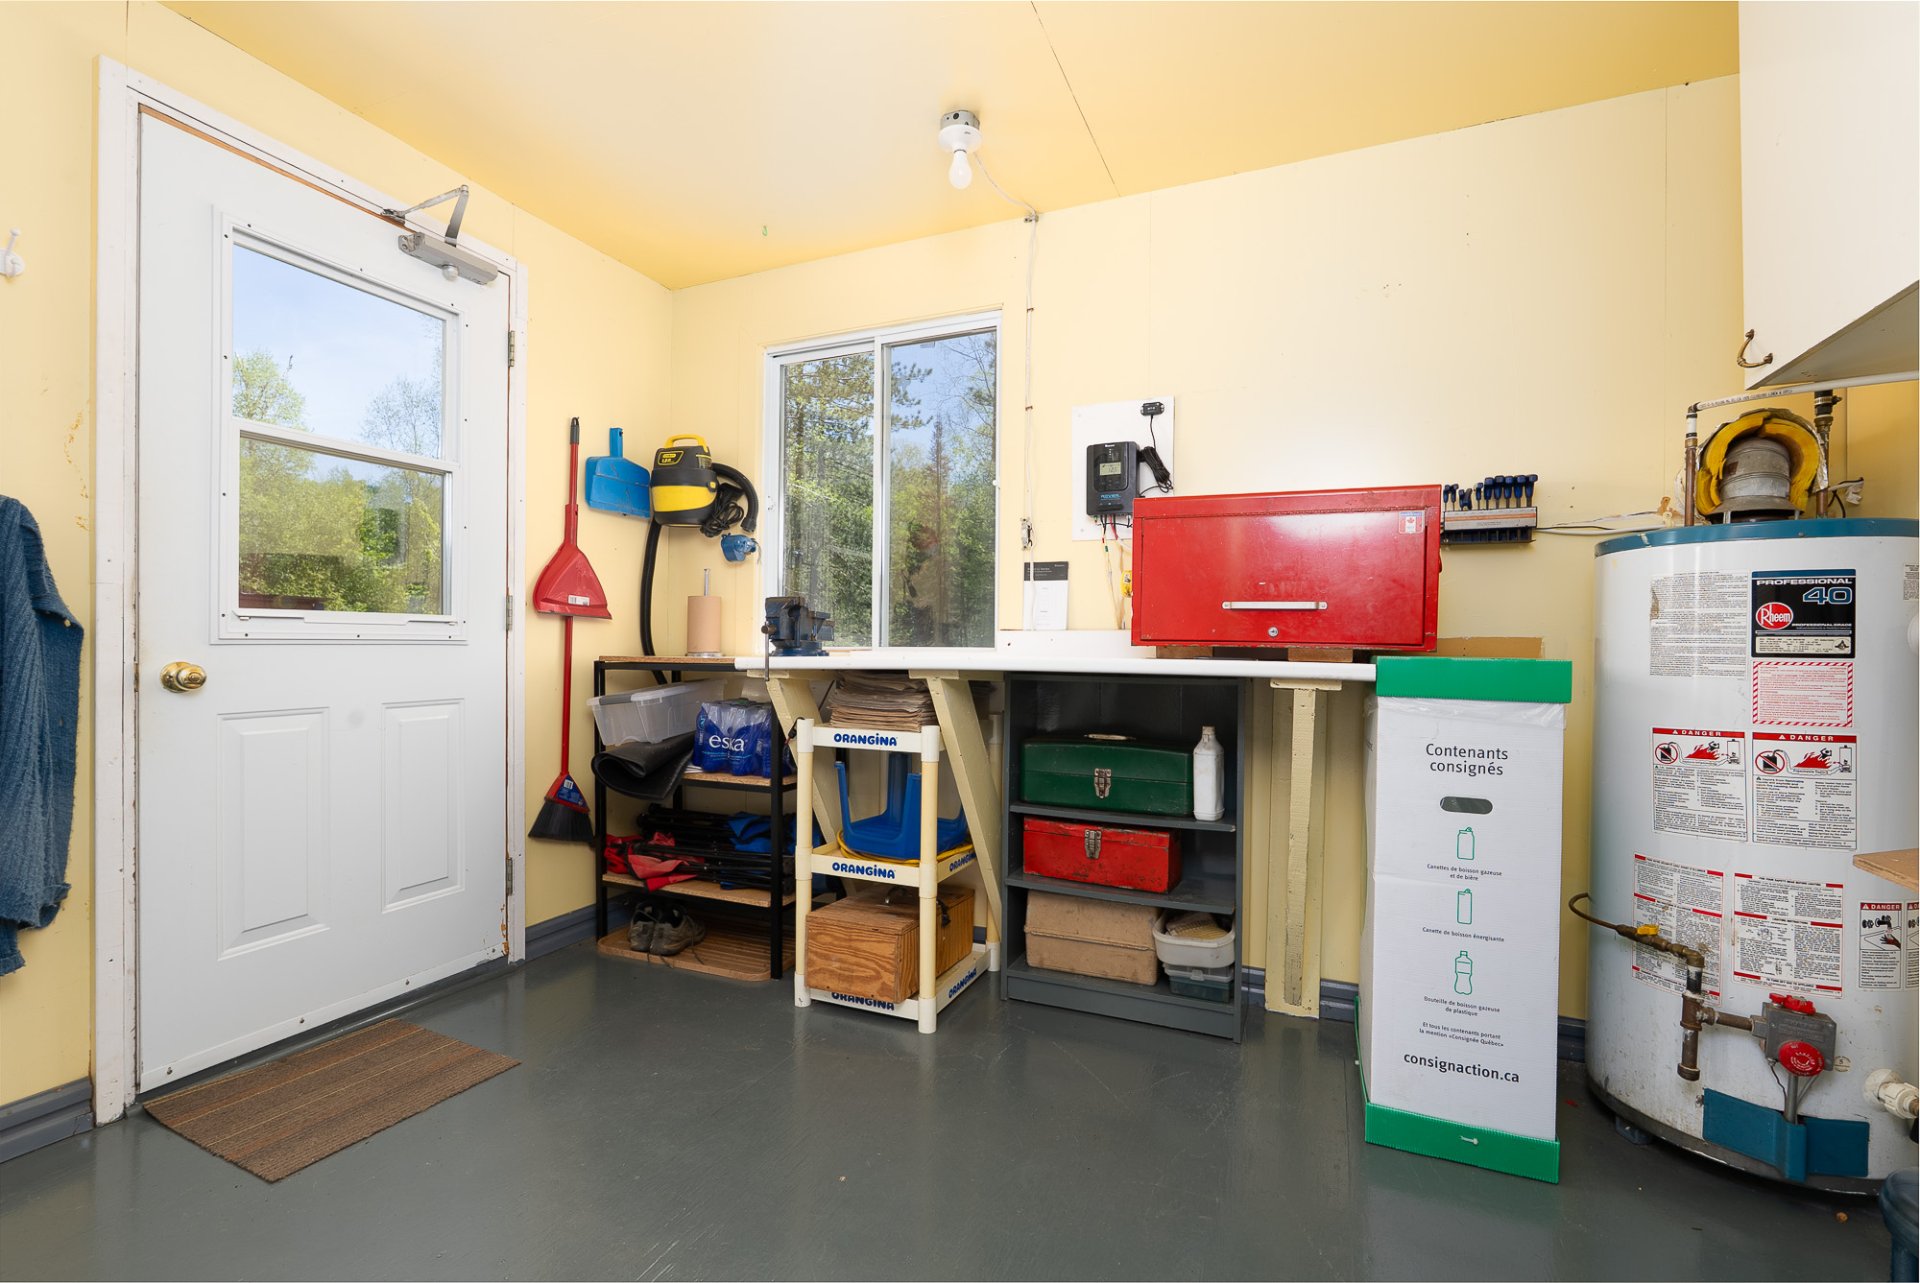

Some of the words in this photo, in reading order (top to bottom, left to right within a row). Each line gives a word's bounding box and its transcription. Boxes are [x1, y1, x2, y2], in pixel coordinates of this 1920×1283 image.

[1756, 578, 1852, 586] PROFESSIONAL
[1802, 586, 1852, 605] 40
[1760, 604, 1791, 626] Rheem
[834, 732, 897, 746] ORANGINA
[1681, 729, 1721, 737] DANGER
[708, 734, 744, 752] eska
[1426, 743, 1508, 760] Contenants
[1430, 760, 1504, 777] consignés
[832, 862, 896, 879] ORANGINA
[1458, 866, 1479, 874] boisson
[1441, 1024, 1450, 1032] les
[1450, 1027, 1480, 1036] contenants
[1403, 1053, 1520, 1083] consignaction.ca
